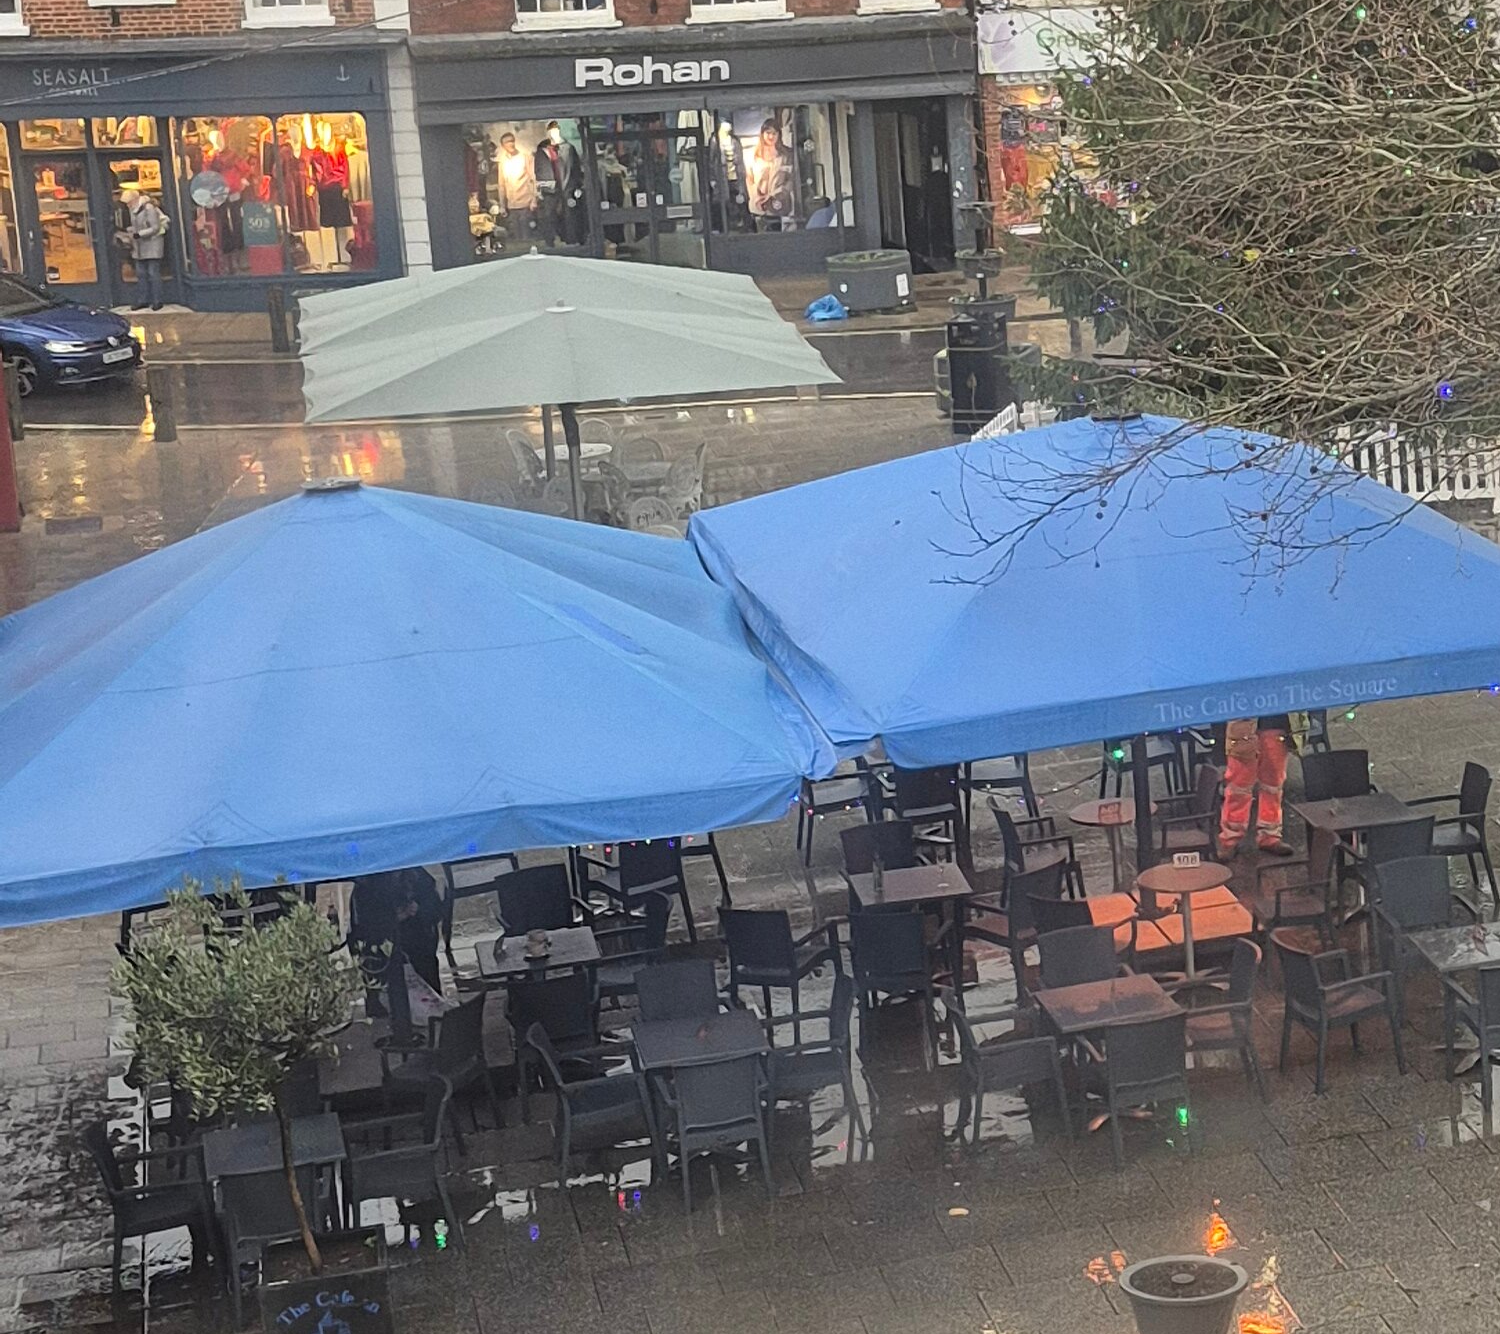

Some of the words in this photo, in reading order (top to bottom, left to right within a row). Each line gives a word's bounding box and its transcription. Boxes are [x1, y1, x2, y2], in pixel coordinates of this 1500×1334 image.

[33, 68, 110, 86] SEASALT
[575, 55, 730, 88] Rohan
[1154, 702, 1193, 723] The
[1254, 693, 1279, 709] on
[1284, 683, 1326, 704] The
[1328, 676, 1398, 701] Square
[276, 1302, 312, 1325] The
